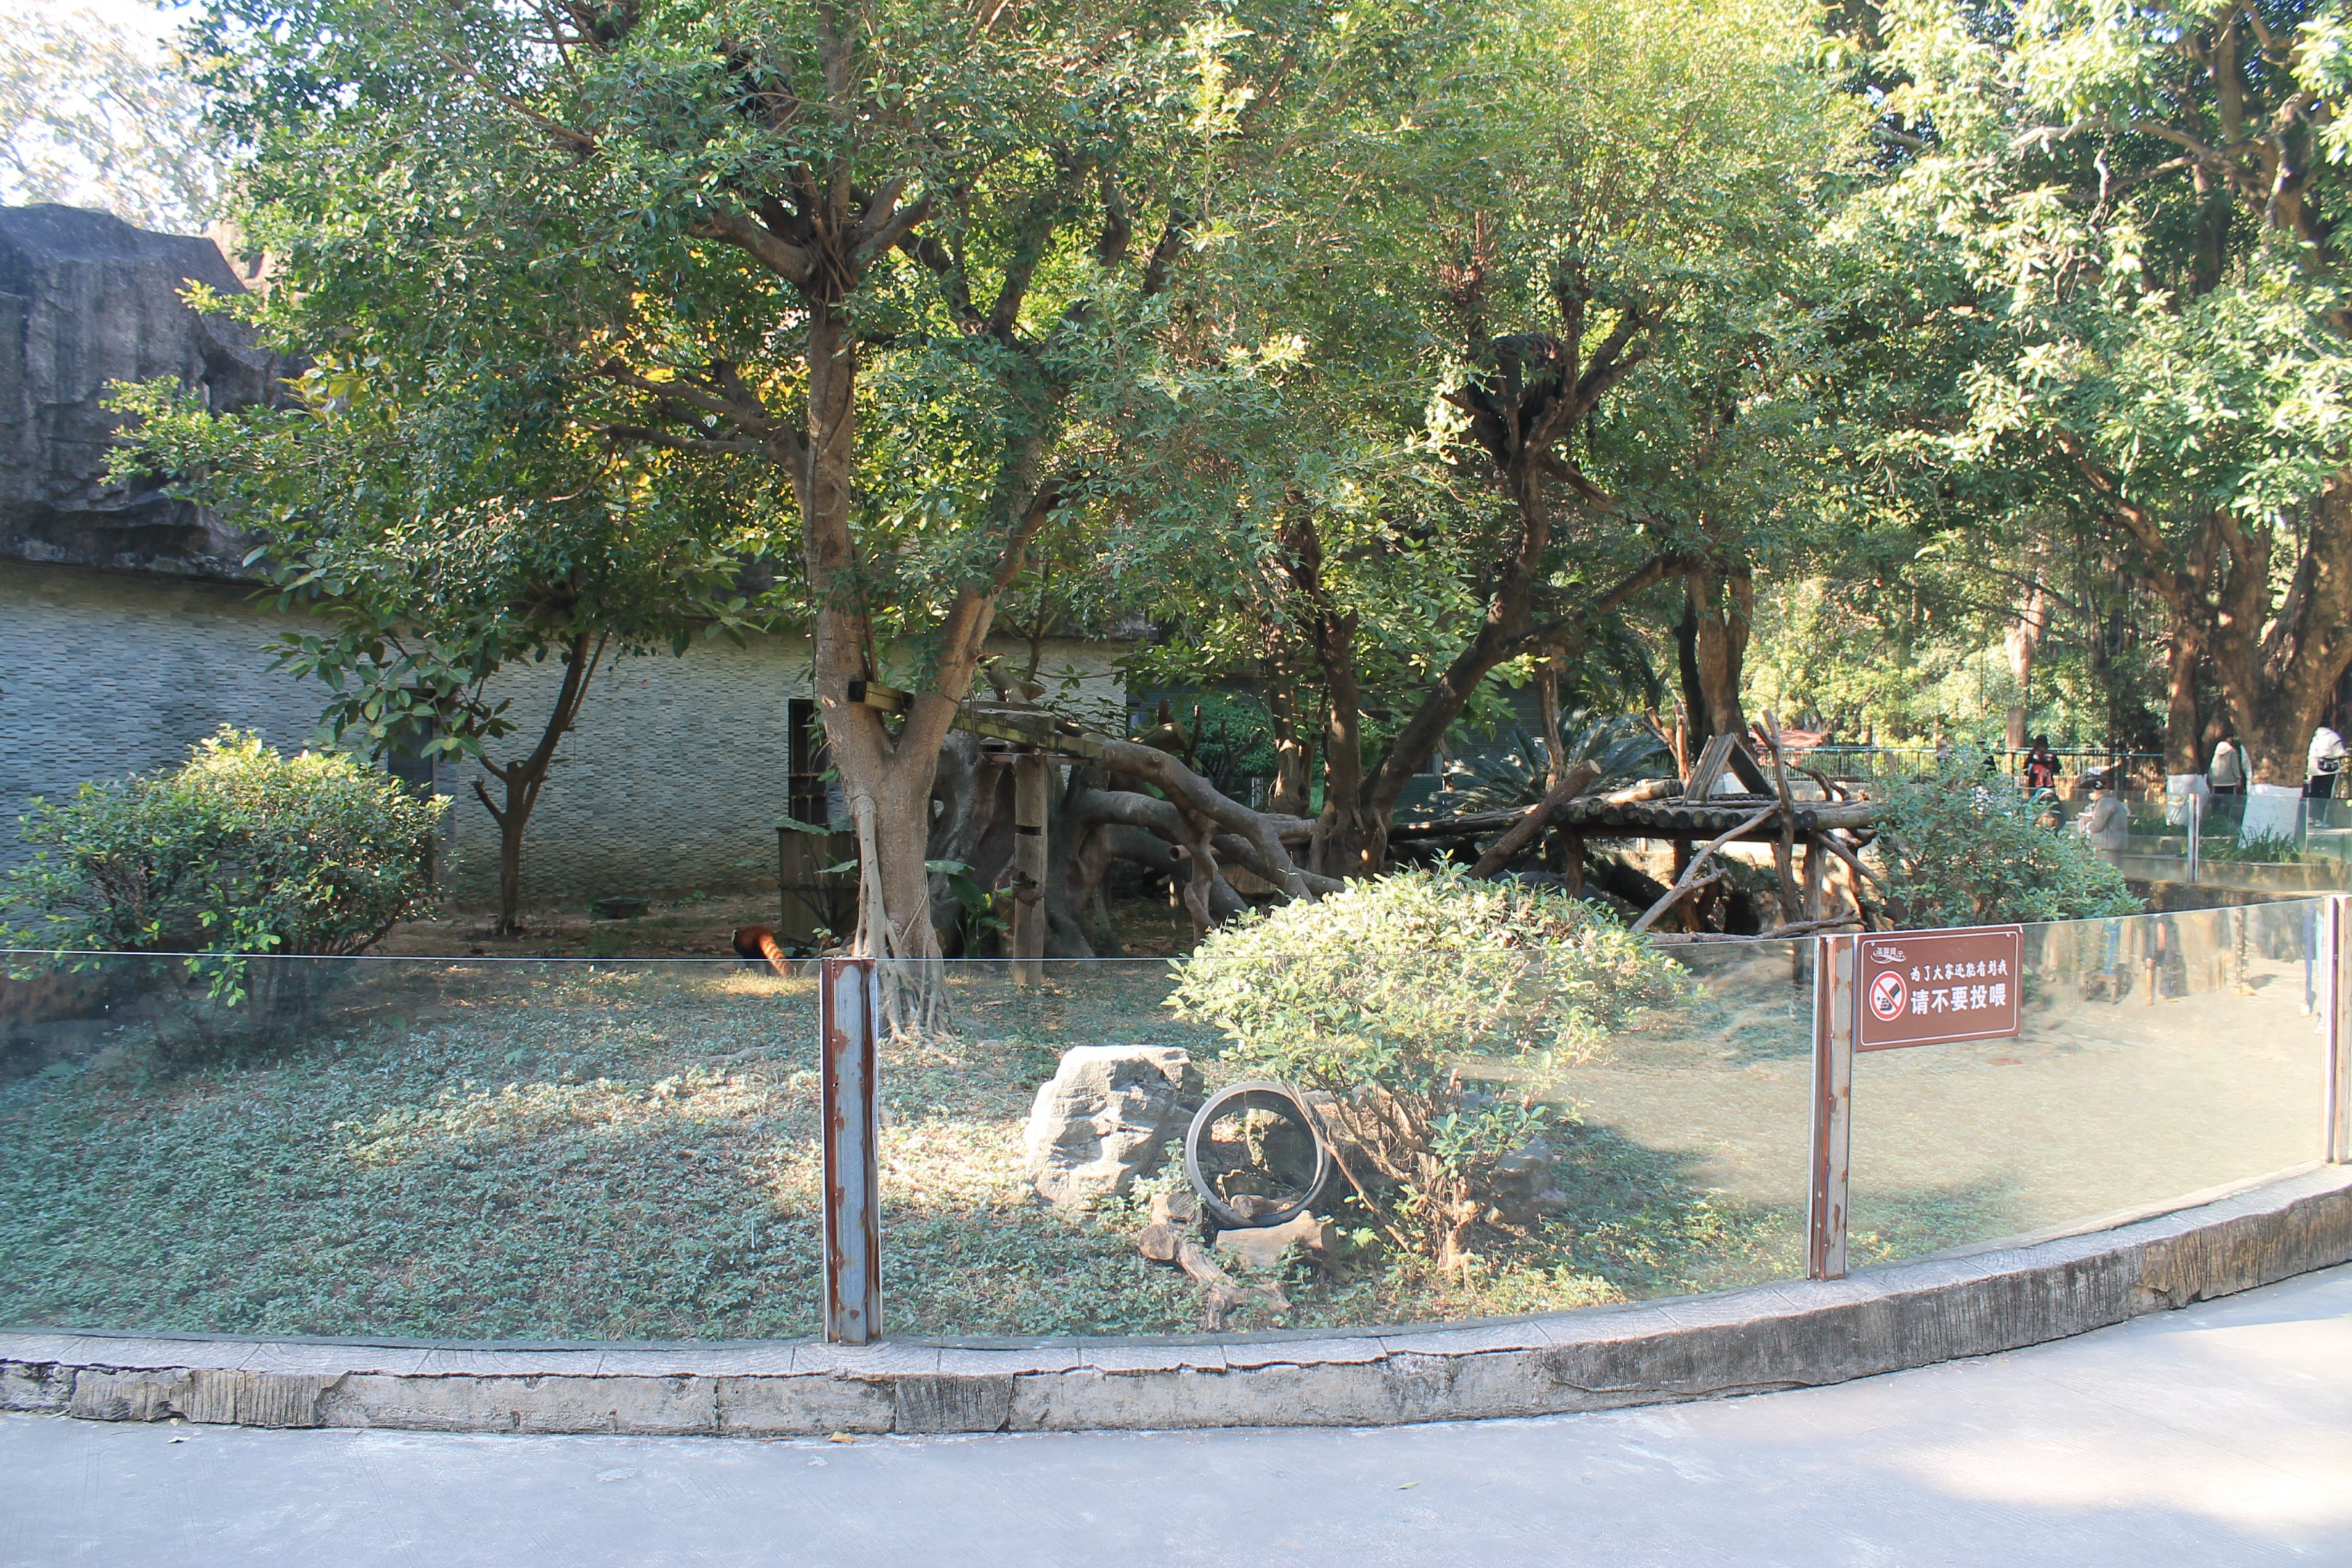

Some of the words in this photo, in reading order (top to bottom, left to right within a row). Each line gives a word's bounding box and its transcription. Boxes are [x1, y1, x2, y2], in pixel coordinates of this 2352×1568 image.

[1910, 959, 2008, 981] 为了大家还能看到我
[1911, 983, 2006, 1015] 请不要投喂
